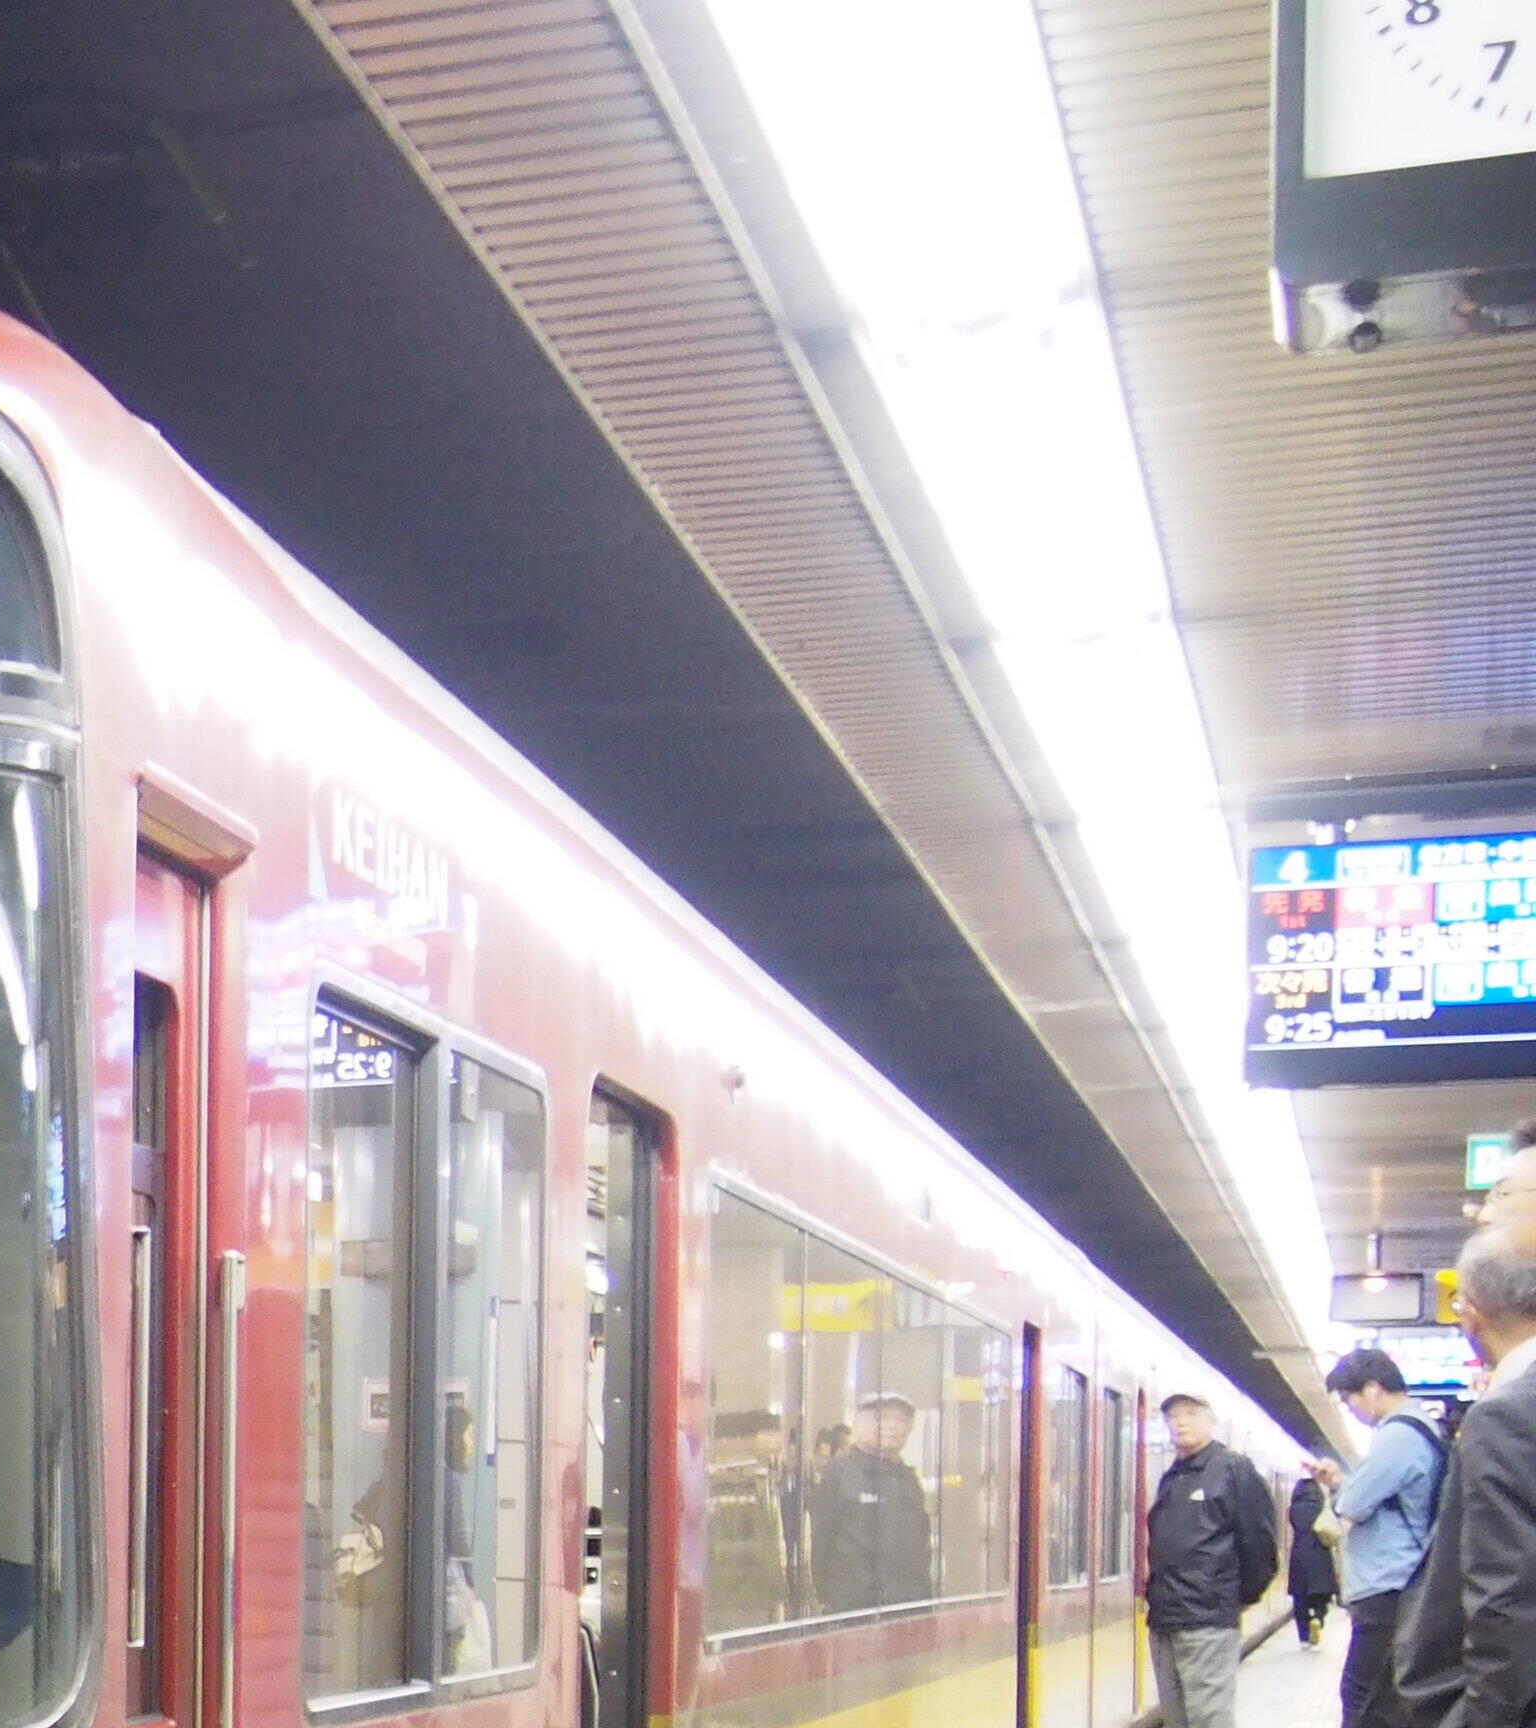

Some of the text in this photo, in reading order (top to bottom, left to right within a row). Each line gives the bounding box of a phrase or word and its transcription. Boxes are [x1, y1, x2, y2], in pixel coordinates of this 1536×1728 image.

[1482, 40, 1516, 83] 7
[331, 786, 449, 928] KEIHAN
[1279, 850, 1309, 884] 4
[1267, 931, 1335, 964] 9:20
[1264, 1011, 1333, 1043] 9:25
